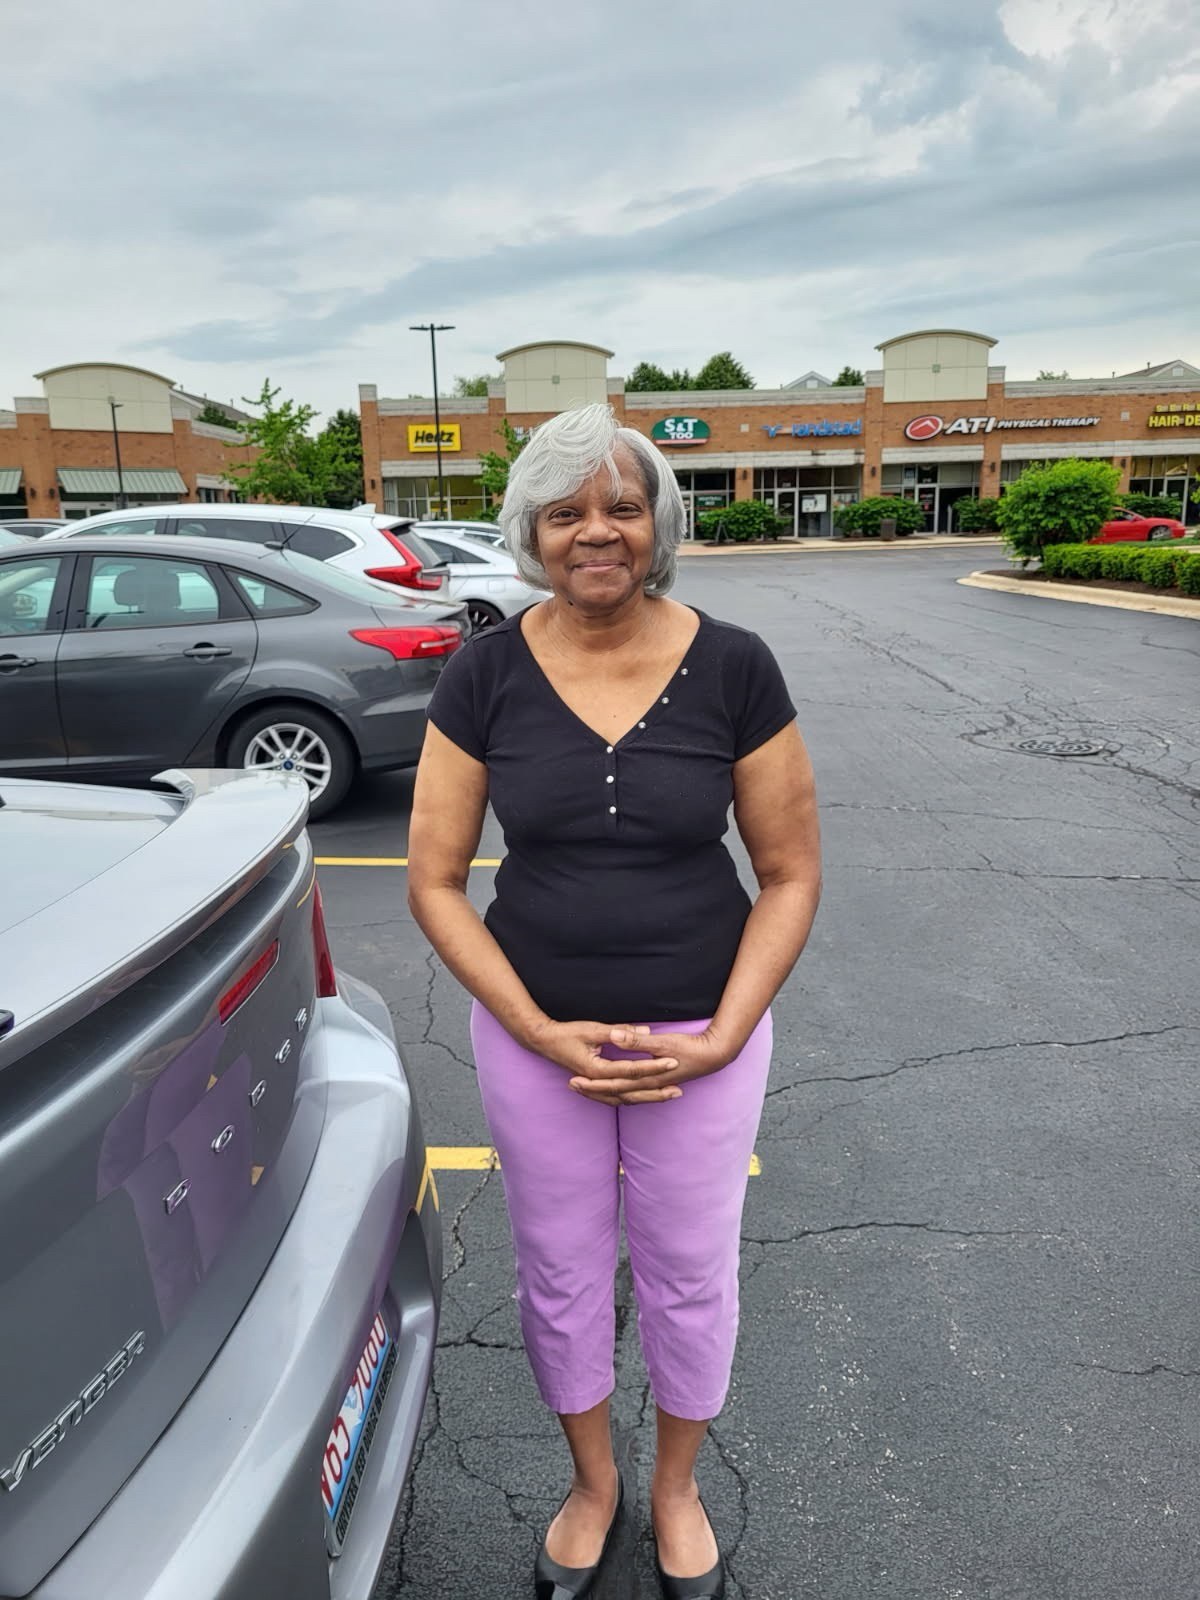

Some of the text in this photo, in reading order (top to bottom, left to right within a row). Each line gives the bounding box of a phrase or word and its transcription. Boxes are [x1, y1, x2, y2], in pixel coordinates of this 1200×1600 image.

[664, 418, 698, 432] S&T
[791, 417, 864, 437] randstad
[945, 416, 1101, 434] ATI PHYSICAL THERAPY
[1148, 415, 1180, 427] HAIR
[669, 431, 693, 440] TOO
